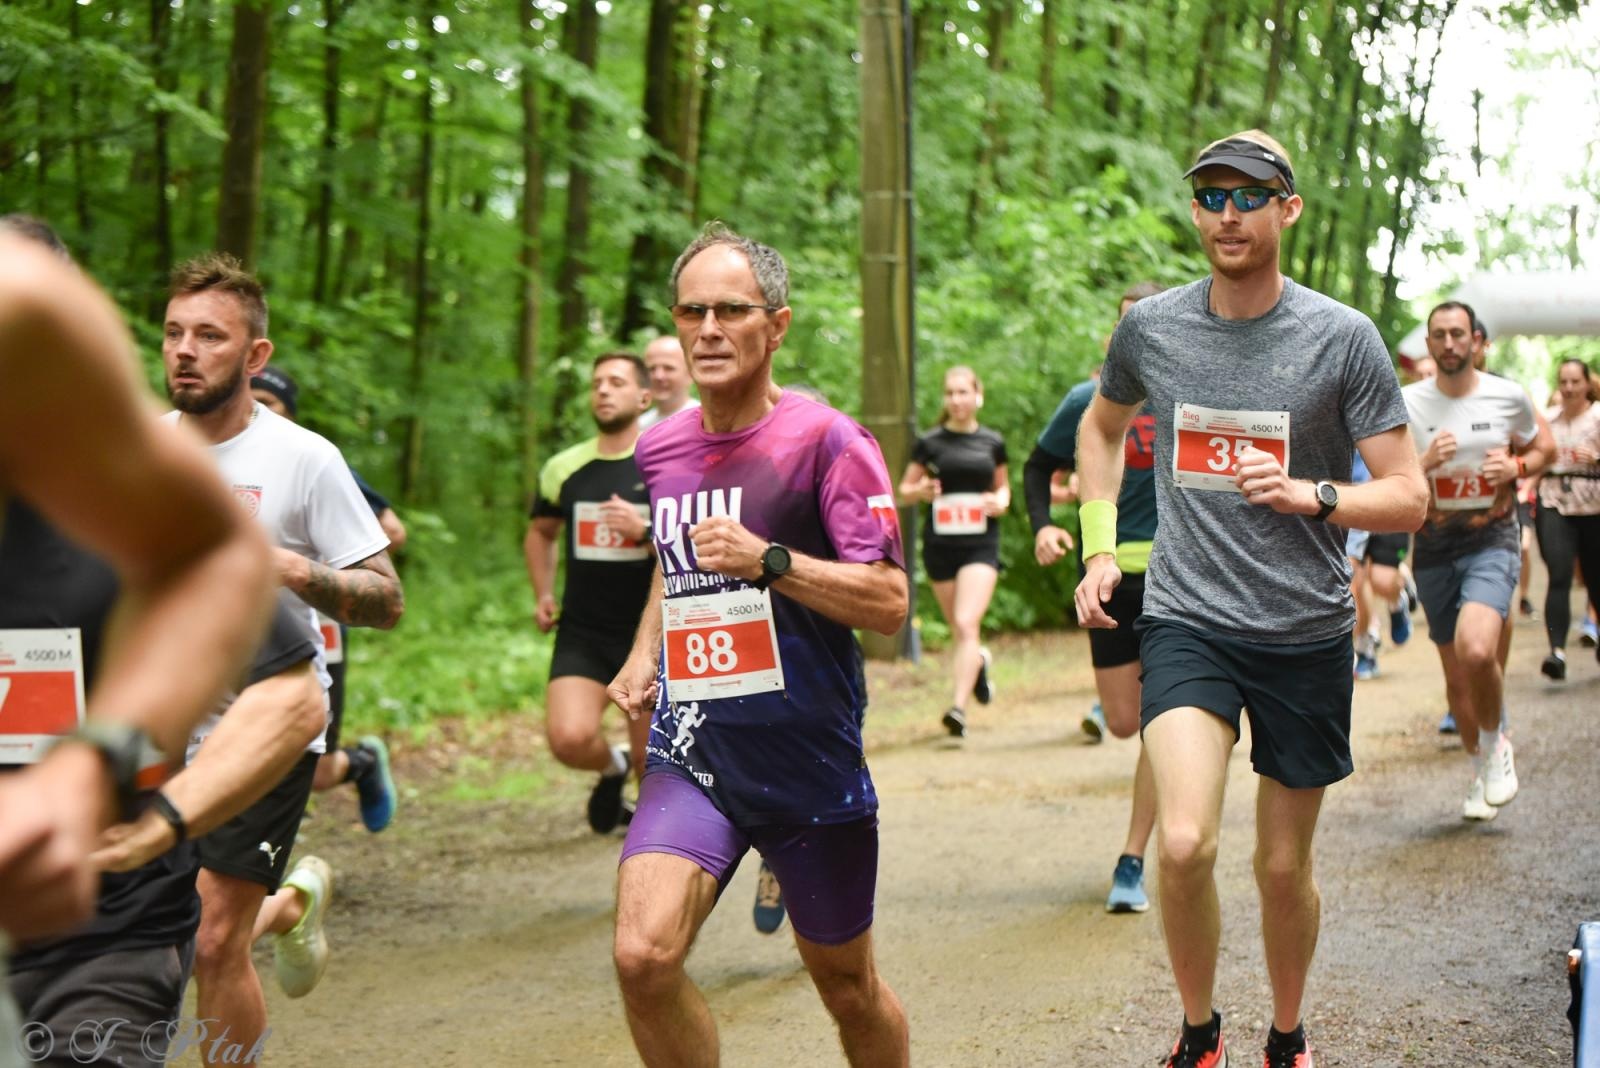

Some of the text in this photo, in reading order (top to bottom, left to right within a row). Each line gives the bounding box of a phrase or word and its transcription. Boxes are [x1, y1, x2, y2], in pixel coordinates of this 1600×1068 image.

[1251, 424, 1284, 433] 4500 M
[1452, 475, 1481, 498] 73
[726, 605, 753, 617] 4500
[754, 603, 765, 614] M
[25, 649, 56, 661] 4500
[686, 630, 738, 675] 88
